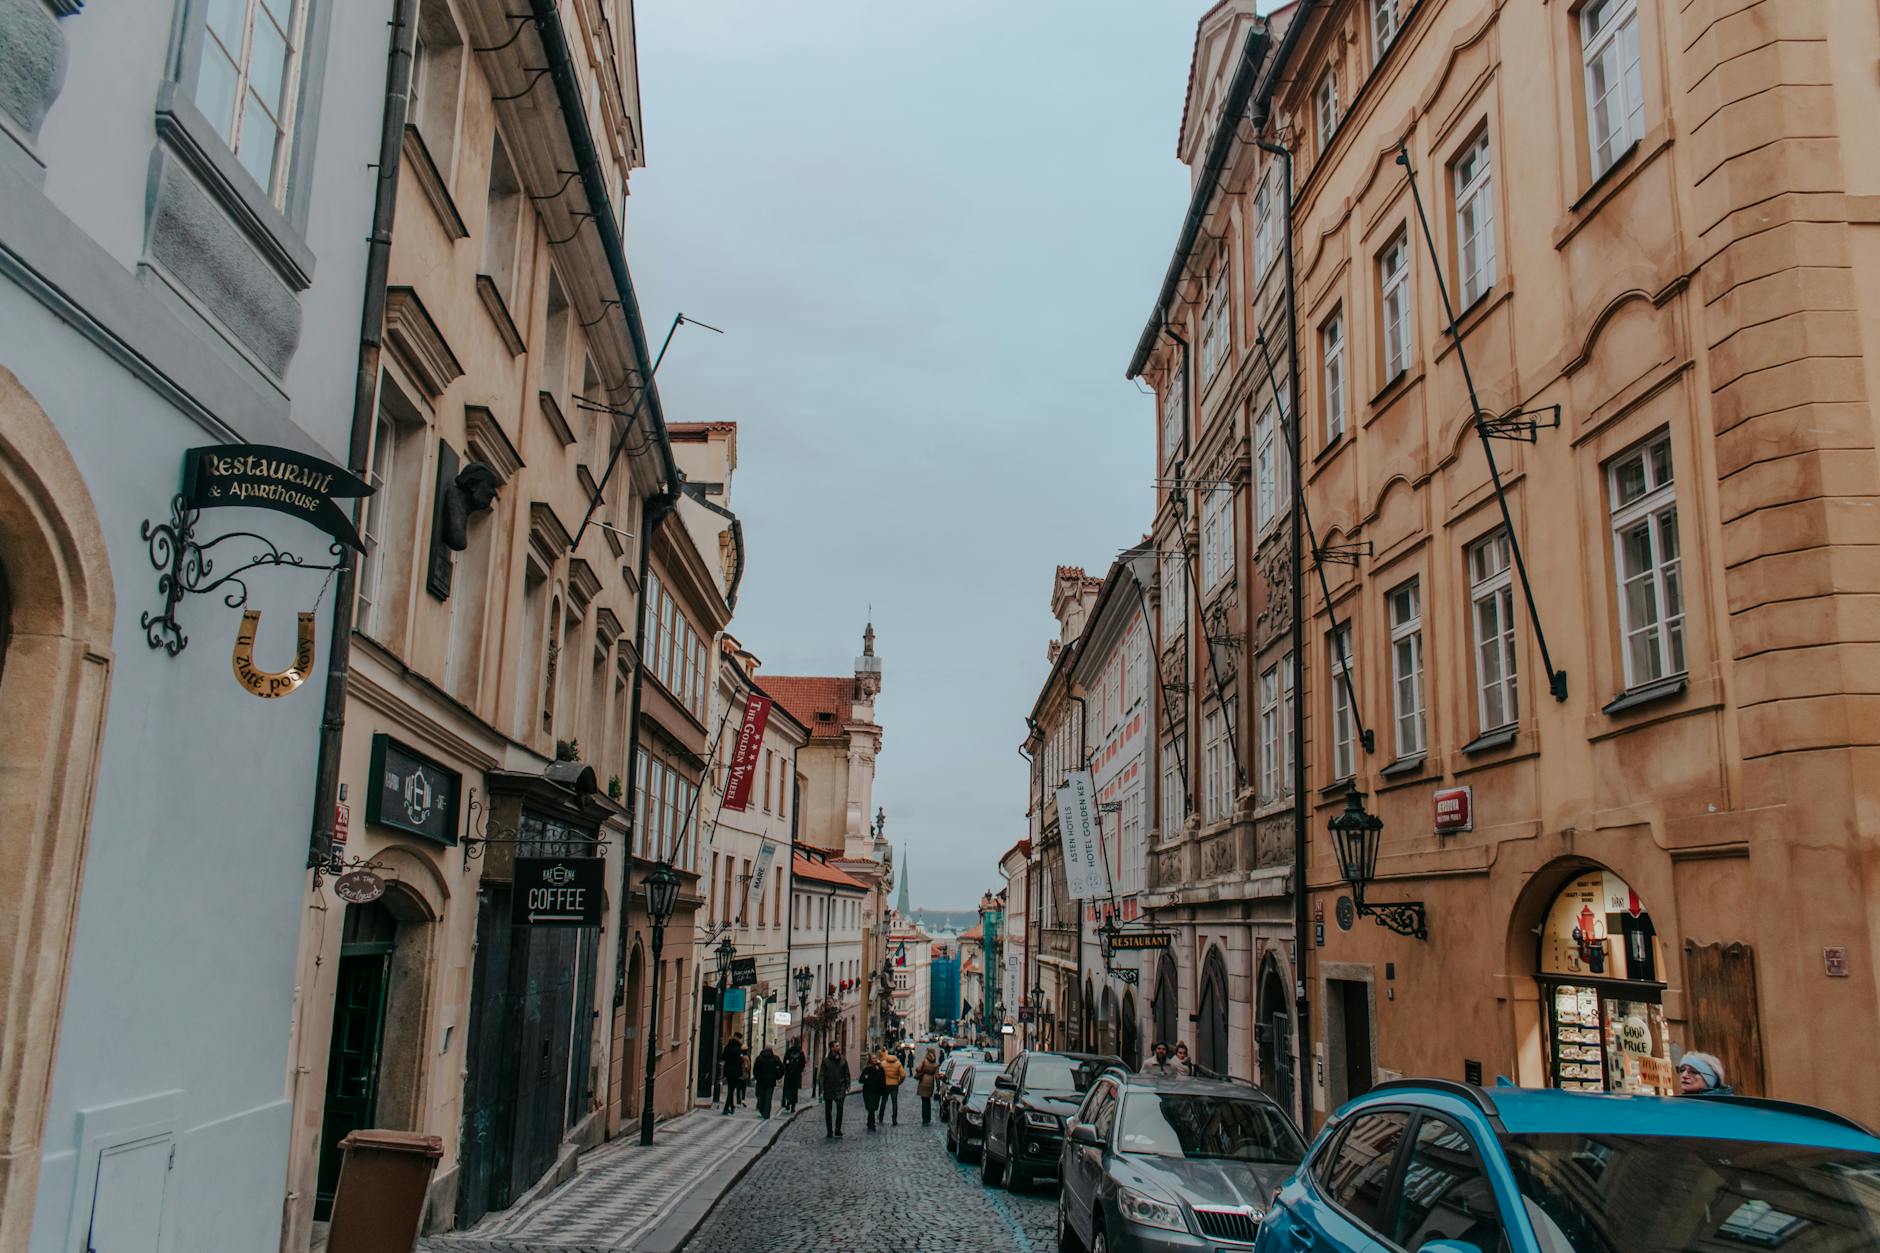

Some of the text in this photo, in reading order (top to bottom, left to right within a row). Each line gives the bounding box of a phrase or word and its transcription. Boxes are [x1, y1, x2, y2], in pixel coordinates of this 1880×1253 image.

[208, 486, 221, 498] &
[1064, 806, 1074, 836] HOTELS
[1076, 779, 1094, 867] HOTEL GOLDEN KEY
[528, 888, 586, 911] COFFEE
[1111, 935, 1169, 948] RESTAURANT
[1623, 1024, 1645, 1039] GOOD
[1623, 1039, 1647, 1053] PRICE
